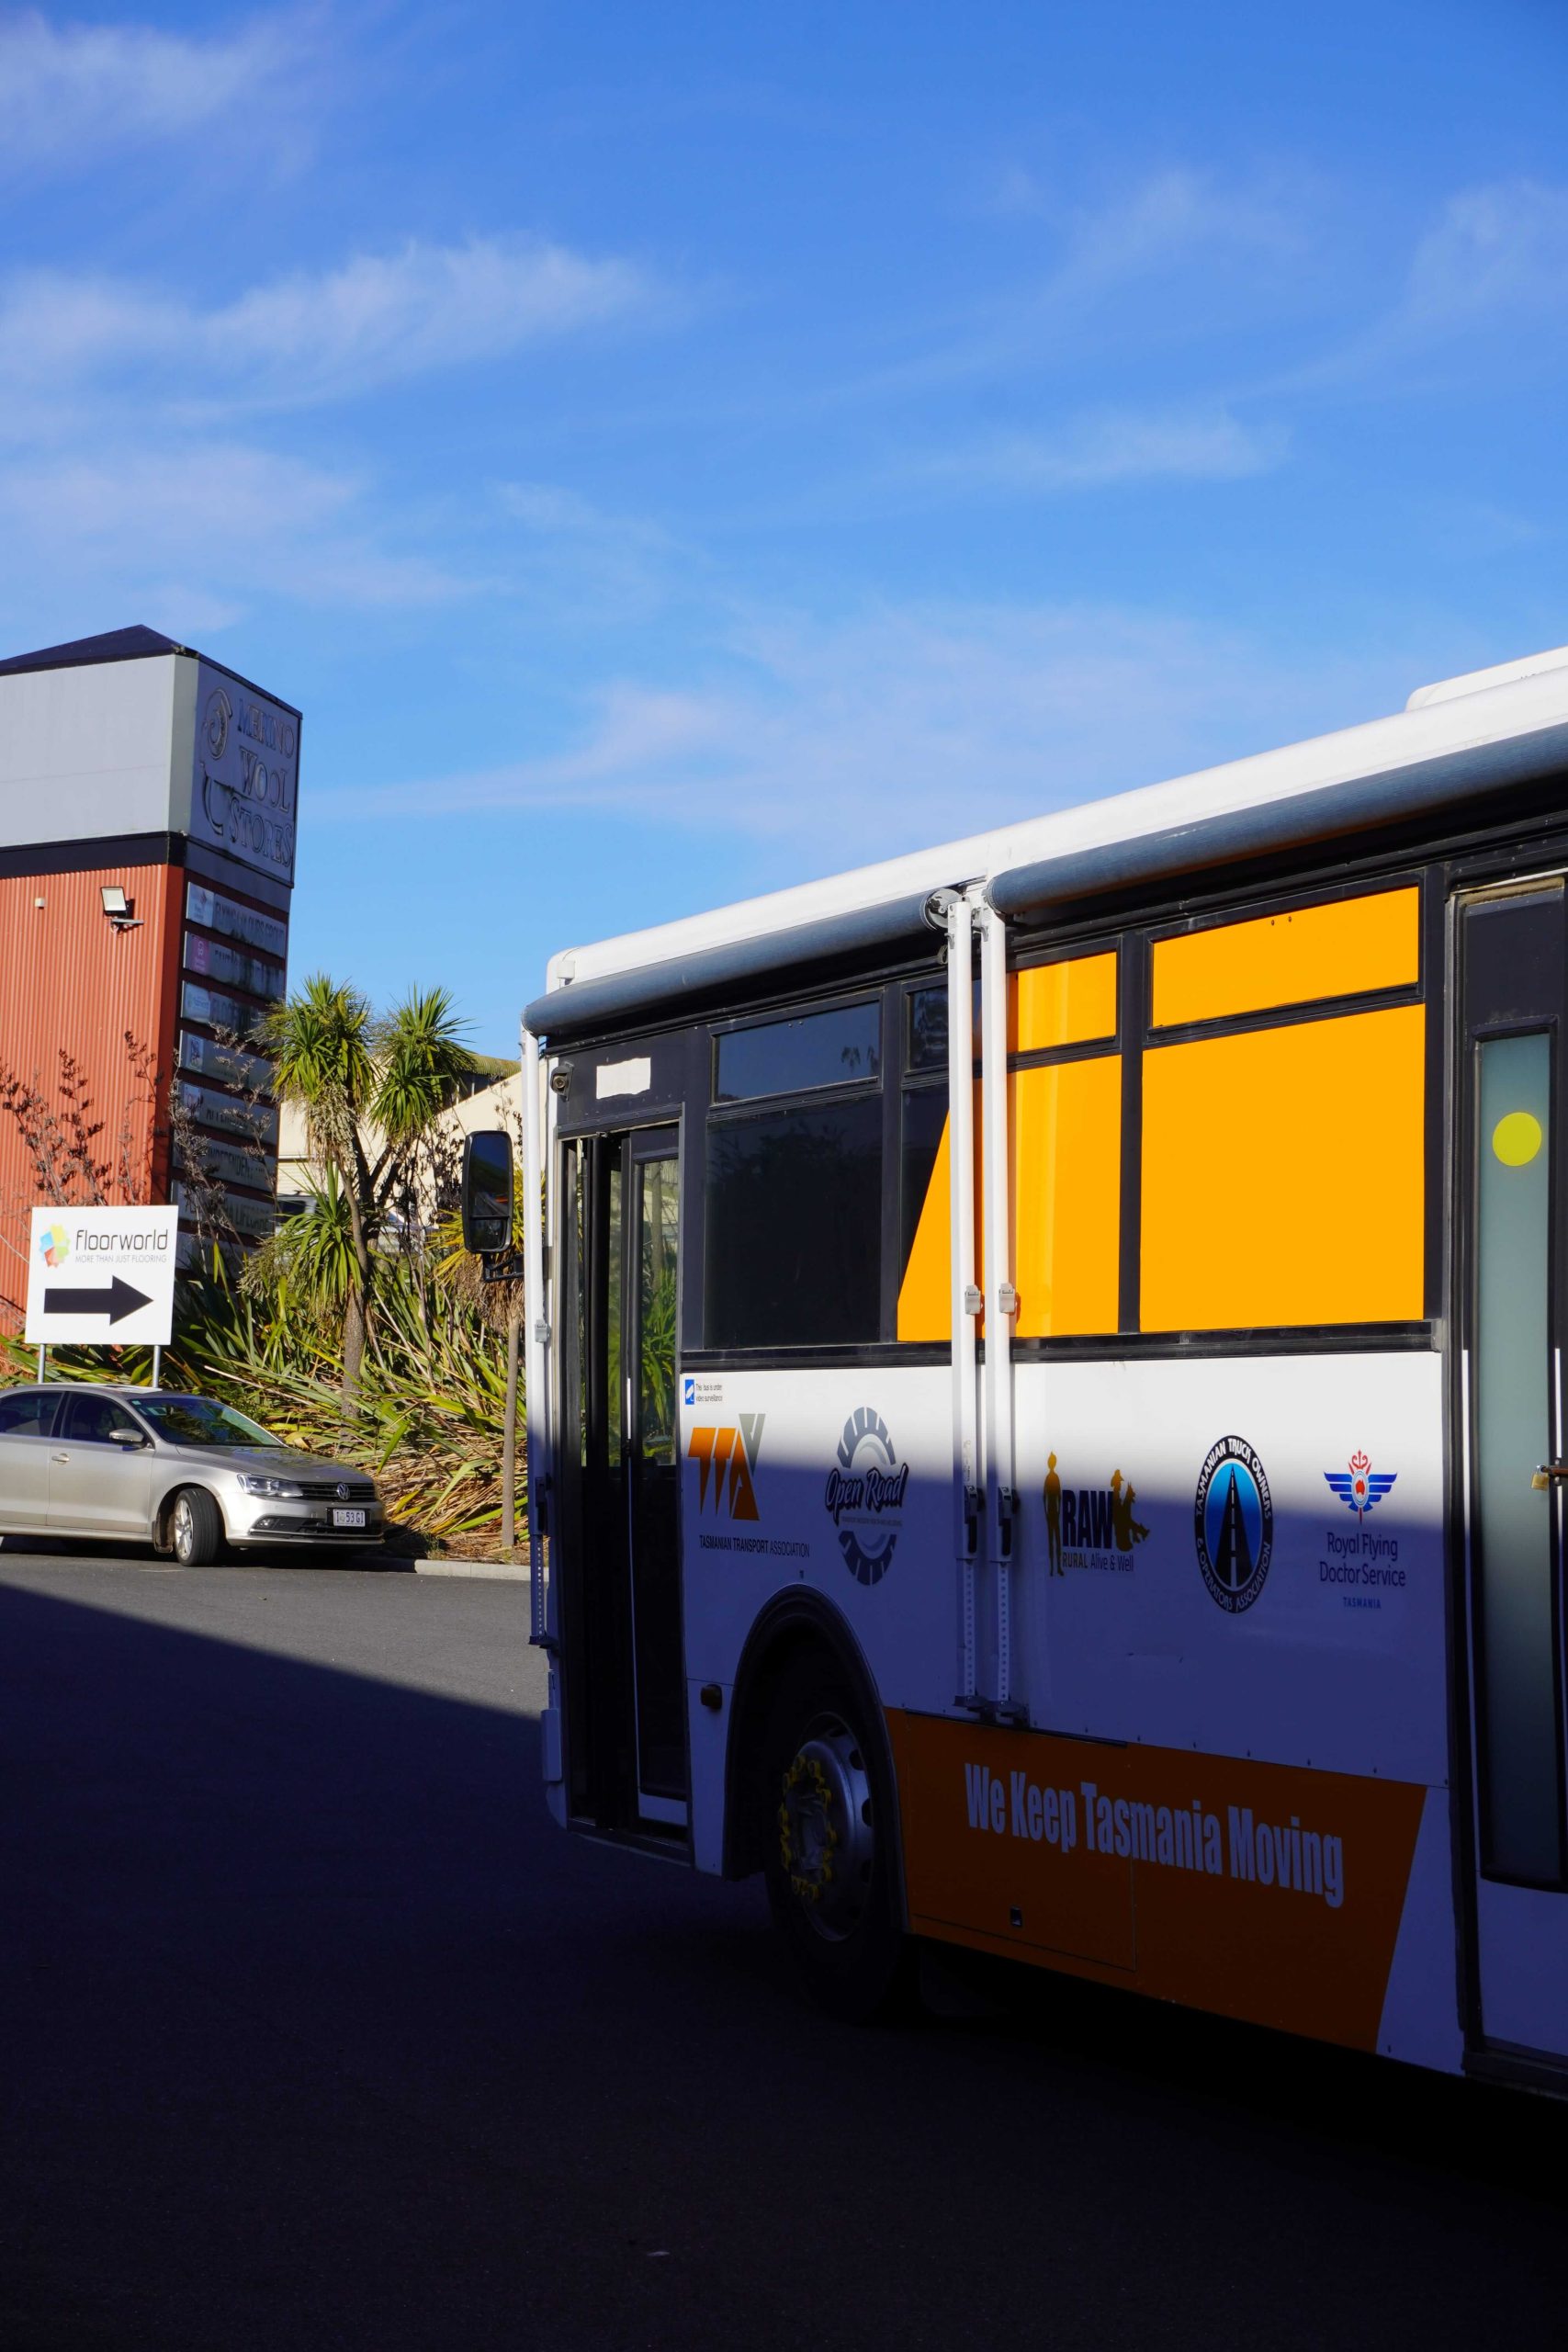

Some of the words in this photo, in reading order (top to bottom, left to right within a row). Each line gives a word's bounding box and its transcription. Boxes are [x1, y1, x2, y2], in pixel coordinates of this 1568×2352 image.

[236, 698, 295, 760] MERINO
[239, 745, 291, 813] WOOL
[229, 794, 293, 868] STORES
[75, 1228, 168, 1250] floorworld
[75, 1255, 95, 1263] MORE
[96, 1255, 113, 1263] THAN
[115, 1254, 130, 1263] JUST
[132, 1254, 167, 1263] FLOORING
[825, 1467, 863, 1527] Open
[865, 1463, 908, 1513] Road
[1196, 1441, 1226, 1517] TASMANIAN
[1227, 1438, 1252, 1464] TRUCK
[1252, 1457, 1271, 1520] OWNERS
[699, 1534, 732, 1551] TASMANIAN
[733, 1537, 769, 1554] TRANSPORT
[770, 1540, 810, 1558] ASSOCIATION
[1062, 1489, 1114, 1549] RAW
[1326, 1532, 1359, 1559] Royal
[1361, 1533, 1398, 1562] Flying
[1062, 1552, 1088, 1569] RURAL
[1090, 1553, 1108, 1570] Alive
[1110, 1555, 1116, 1571] &
[1117, 1555, 1134, 1572] Well
[1200, 1551, 1233, 1611] OPERATORS
[1235, 1541, 1271, 1612] ASSOCIATION
[1319, 1561, 1360, 1584] Doctor
[1361, 1563, 1406, 1587] Service
[1343, 1596, 1382, 1610] TASMANIA
[964, 1762, 1006, 1836] We
[1010, 1770, 1077, 1854] Keep
[1080, 1781, 1224, 1876] Tasmania
[1227, 1805, 1345, 1909] Moving
